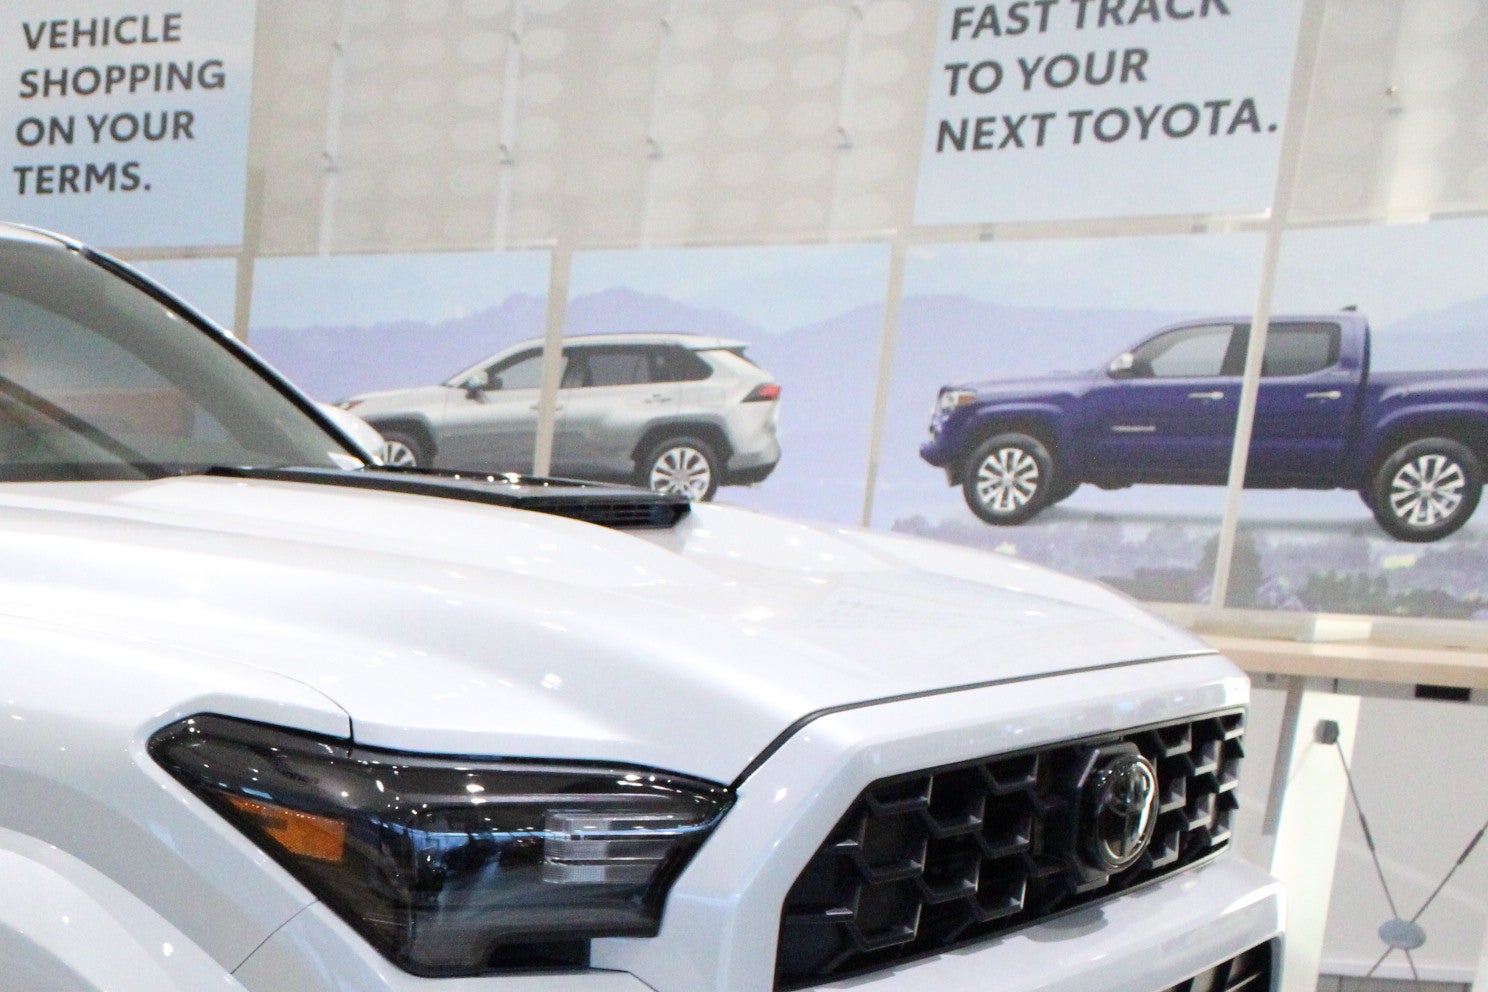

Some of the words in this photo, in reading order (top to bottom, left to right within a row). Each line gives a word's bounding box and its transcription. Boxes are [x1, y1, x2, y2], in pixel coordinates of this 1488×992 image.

[22, 12, 182, 50] VEHICLE
[950, 1, 1058, 41] FAST
[1074, 0, 1231, 29] TRACK
[18, 59, 226, 99] SHOPPING
[944, 60, 1003, 97] TO
[1017, 48, 1149, 91] YOUR
[15, 115, 75, 147] ON
[86, 110, 196, 143] YOUR
[936, 112, 1056, 153] NEXT
[1068, 97, 1279, 146] TOYOTA.
[13, 161, 152, 195] TERMS.
